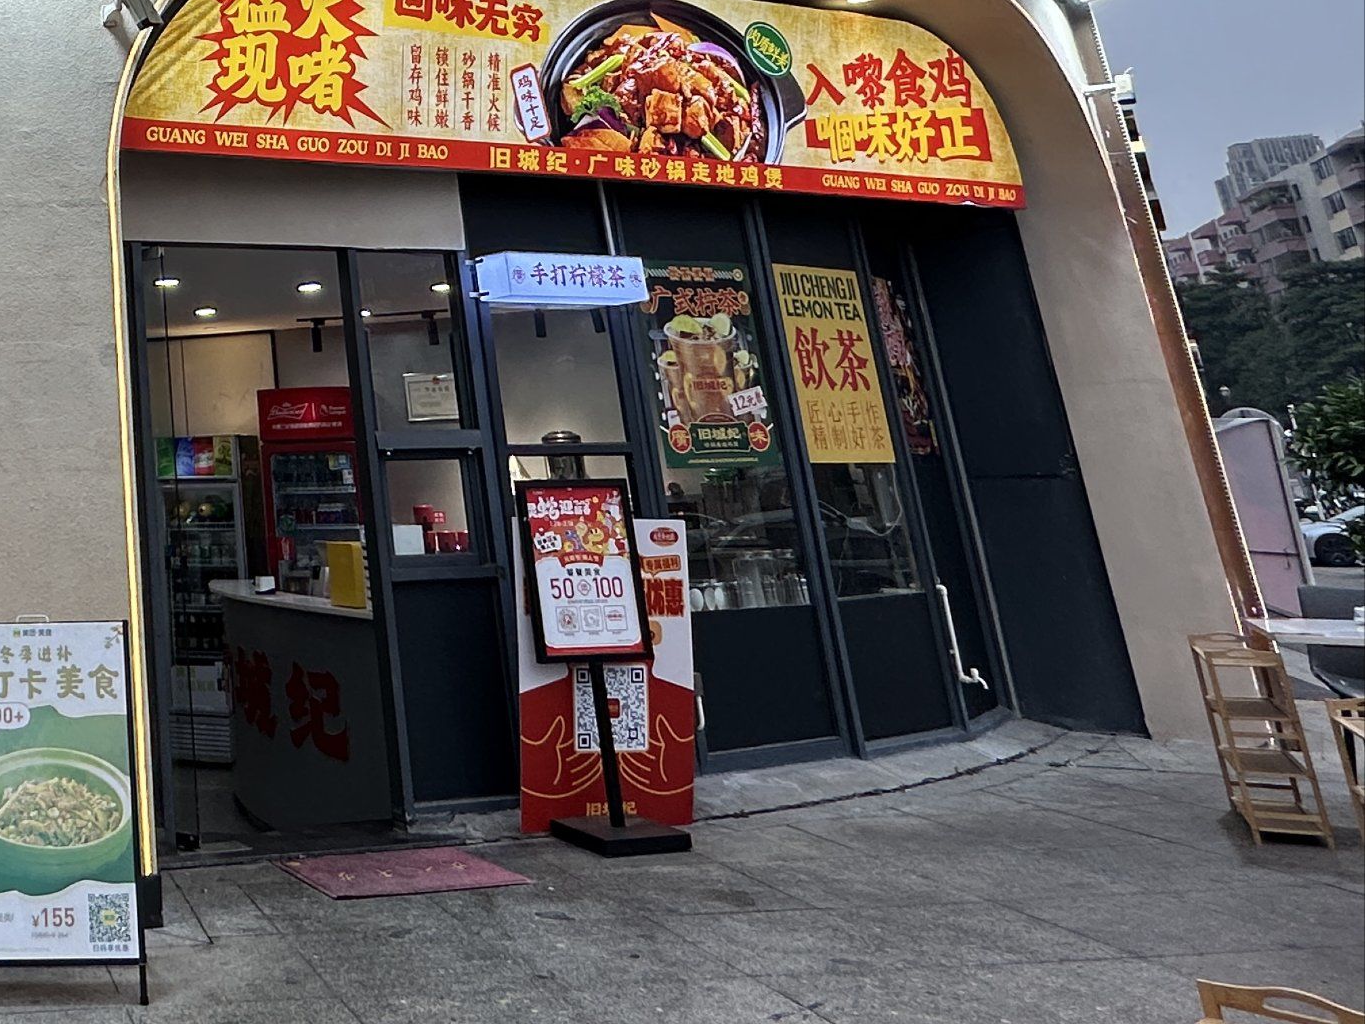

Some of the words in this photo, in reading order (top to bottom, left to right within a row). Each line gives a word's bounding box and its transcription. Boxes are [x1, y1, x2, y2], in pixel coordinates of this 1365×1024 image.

[405, 43, 424, 128] 留存鸡味
[434, 46, 451, 130] 锁住鲜嫩
[460, 49, 476, 131] 砂锅干香
[485, 51, 502, 132] 精准火候
[516, 73, 546, 134] 鸡味十足
[145, 125, 207, 145] GUANG
[214, 130, 249, 148] WEI
[255, 134, 290, 151] SHA
[296, 136, 331, 153] GUO
[337, 138, 368, 156] ZOU
[375, 140, 392, 157] DI
[397, 142, 411, 160] JI
[417, 143, 449, 160] BAO
[489, 145, 784, 190] 旧城纪·广味砂锅走地鸡煲
[821, 175, 860, 191] GUANG
[864, 177, 887, 193] WEI
[890, 179, 913, 194] SHA
[918, 181, 940, 196] GUO
[945, 182, 970, 198] ZOU
[974, 185, 985, 199] DI
[987, 187, 995, 201] JI
[998, 188, 1016, 202] BAO
[529, 262, 626, 288] 手打柠檬茶
[650, 285, 741, 317] 广式柠茶
[785, 300, 833, 320] LEMON
[834, 302, 863, 322] TEA
[794, 326, 871, 392] 飲茶
[806, 399, 880, 425] 匠心手作
[550, 576, 575, 599] 50
[593, 575, 624, 599] 100
[0, 644, 73, 664] 冬季进补
[586, 801, 638, 817] 旧纪
[31, 907, 75, 928] ¥155
